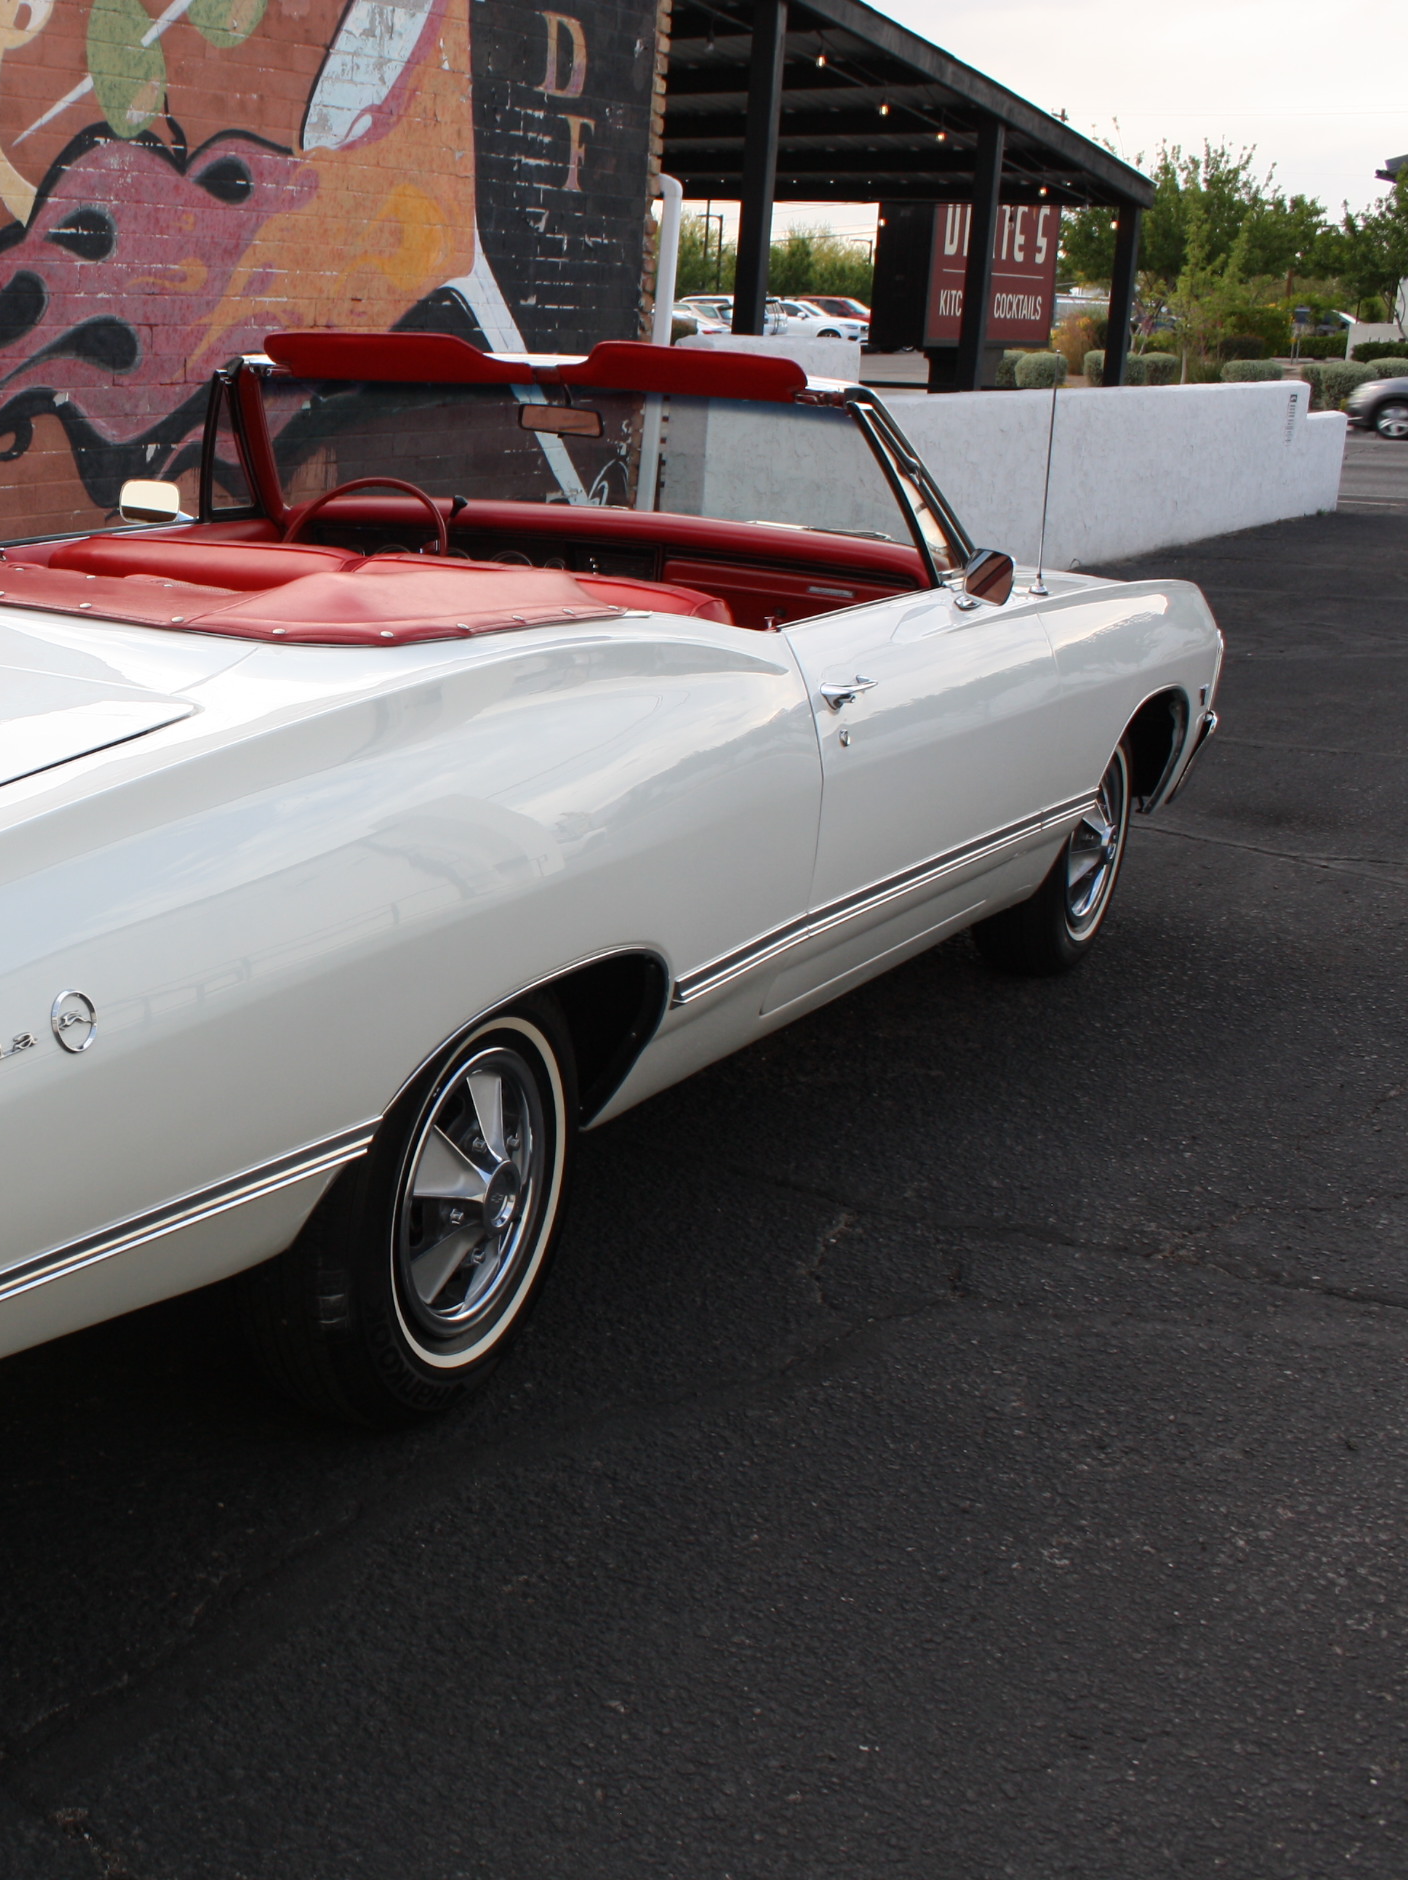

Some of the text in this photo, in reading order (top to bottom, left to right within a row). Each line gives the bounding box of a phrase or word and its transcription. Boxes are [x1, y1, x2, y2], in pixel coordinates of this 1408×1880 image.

[535, 11, 587, 98] D
[561, 115, 595, 191] F
[939, 289, 1042, 320] KITC COCKTAILS
